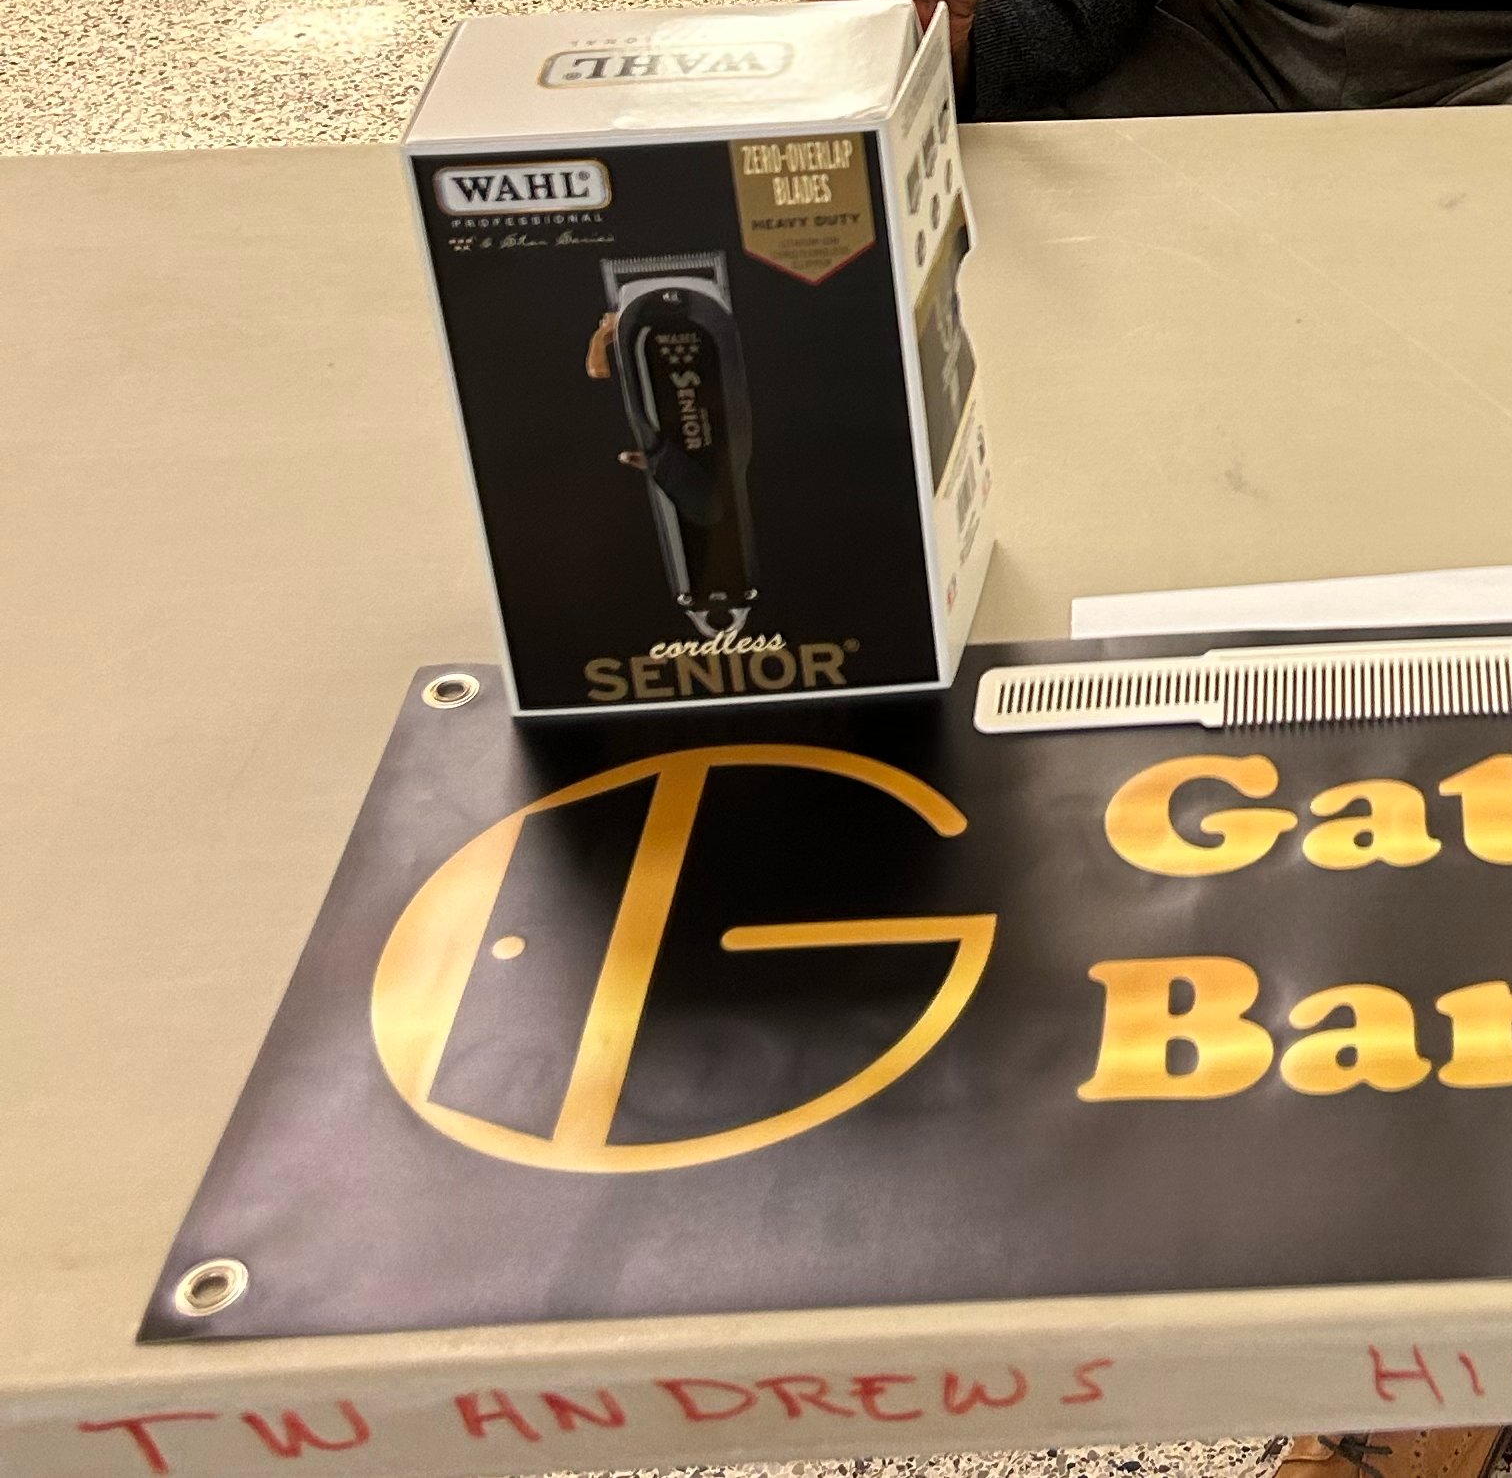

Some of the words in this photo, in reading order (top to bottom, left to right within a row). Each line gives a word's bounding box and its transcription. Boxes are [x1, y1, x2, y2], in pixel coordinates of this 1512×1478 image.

[741, 139, 853, 175] ZERO-OVERLAP
[451, 171, 590, 203] WAHL
[772, 173, 832, 206] BLADES
[451, 213, 604, 228] PROFESSIONAL
[751, 216, 807, 230] HEAVY
[813, 213, 860, 228] DUTY
[649, 630, 787, 660] cordless
[584, 643, 848, 702] SENIOR
[78, 1398, 372, 1476] TW
